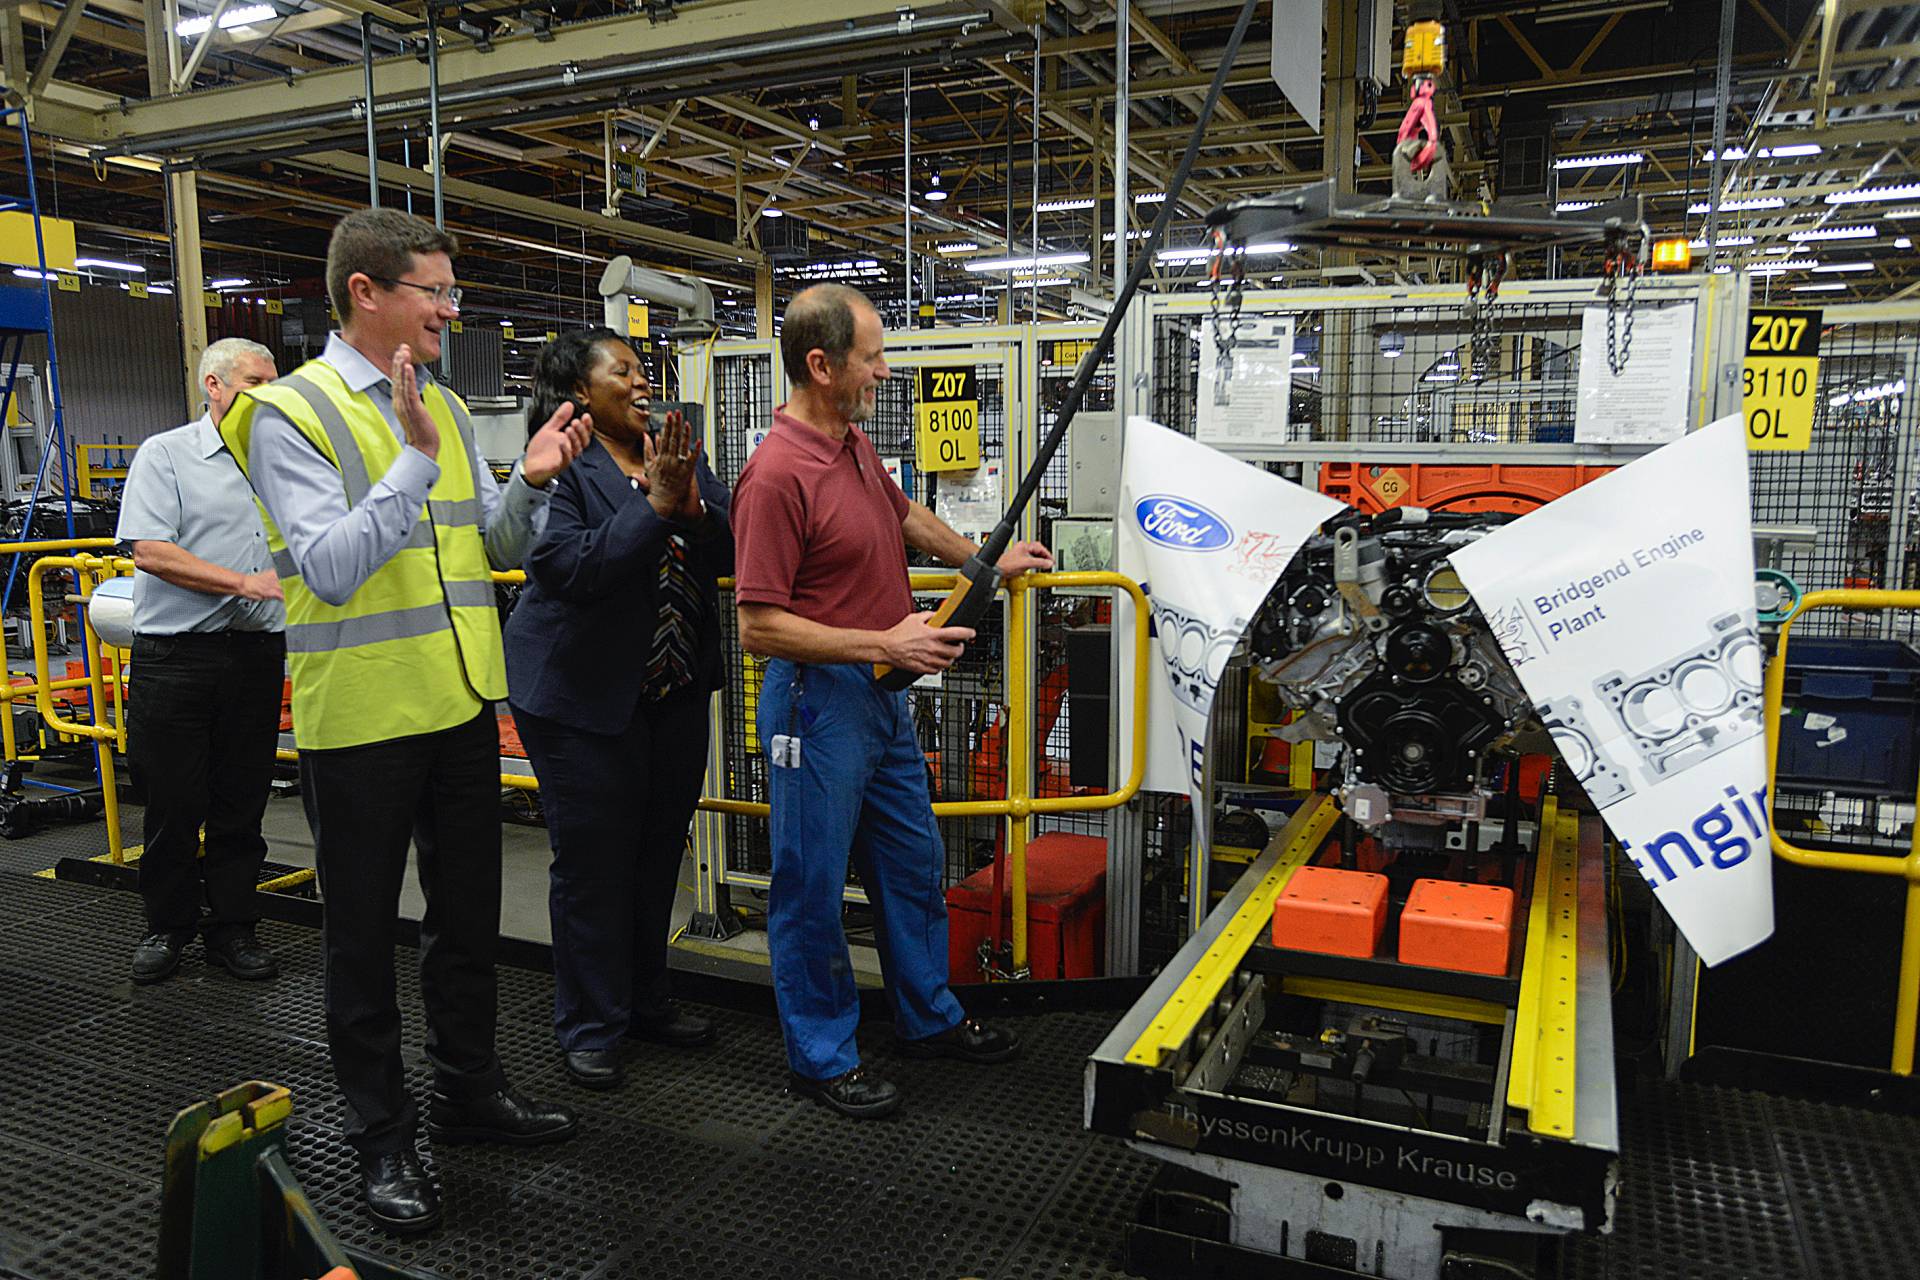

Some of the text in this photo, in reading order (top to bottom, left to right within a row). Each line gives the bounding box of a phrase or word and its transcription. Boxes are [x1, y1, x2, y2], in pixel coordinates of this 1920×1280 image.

[1750, 315, 1808, 351] Z07
[931, 372, 966, 398] Z07
[1743, 367, 1807, 397] 8110
[929, 408, 973, 433] 8100
[1750, 408, 1789, 439] OL
[940, 439, 966, 462] OL
[1383, 482, 1398, 493] CG
[1144, 500, 1211, 544] Ford
[1533, 528, 1705, 615] Bridgend Engine
[1548, 604, 1606, 641] Plant
[1398, 1145, 1516, 1190] Krause
